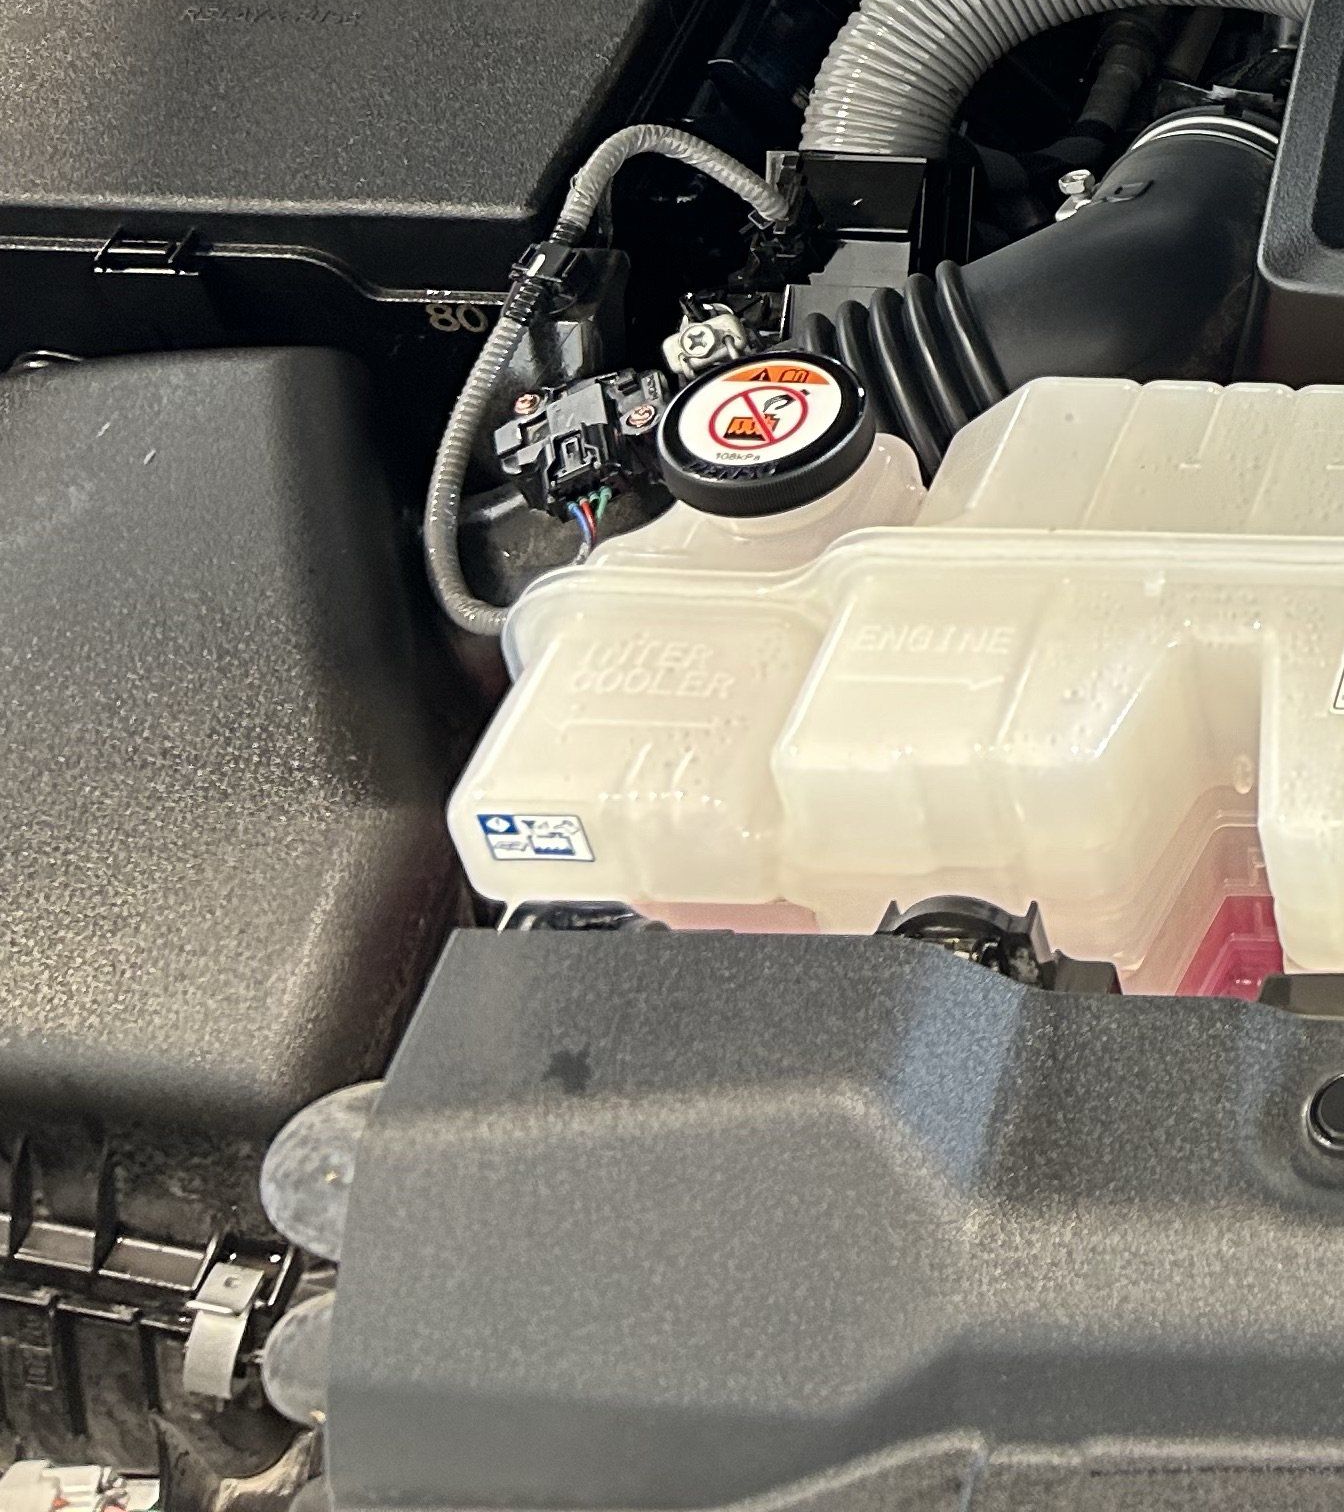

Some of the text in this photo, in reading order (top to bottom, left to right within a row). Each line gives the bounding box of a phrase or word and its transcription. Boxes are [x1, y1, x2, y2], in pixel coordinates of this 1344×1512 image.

[715, 451, 761, 461] 108kPa
[850, 622, 1018, 656] ENGINE
[571, 666, 737, 700] COOLER
